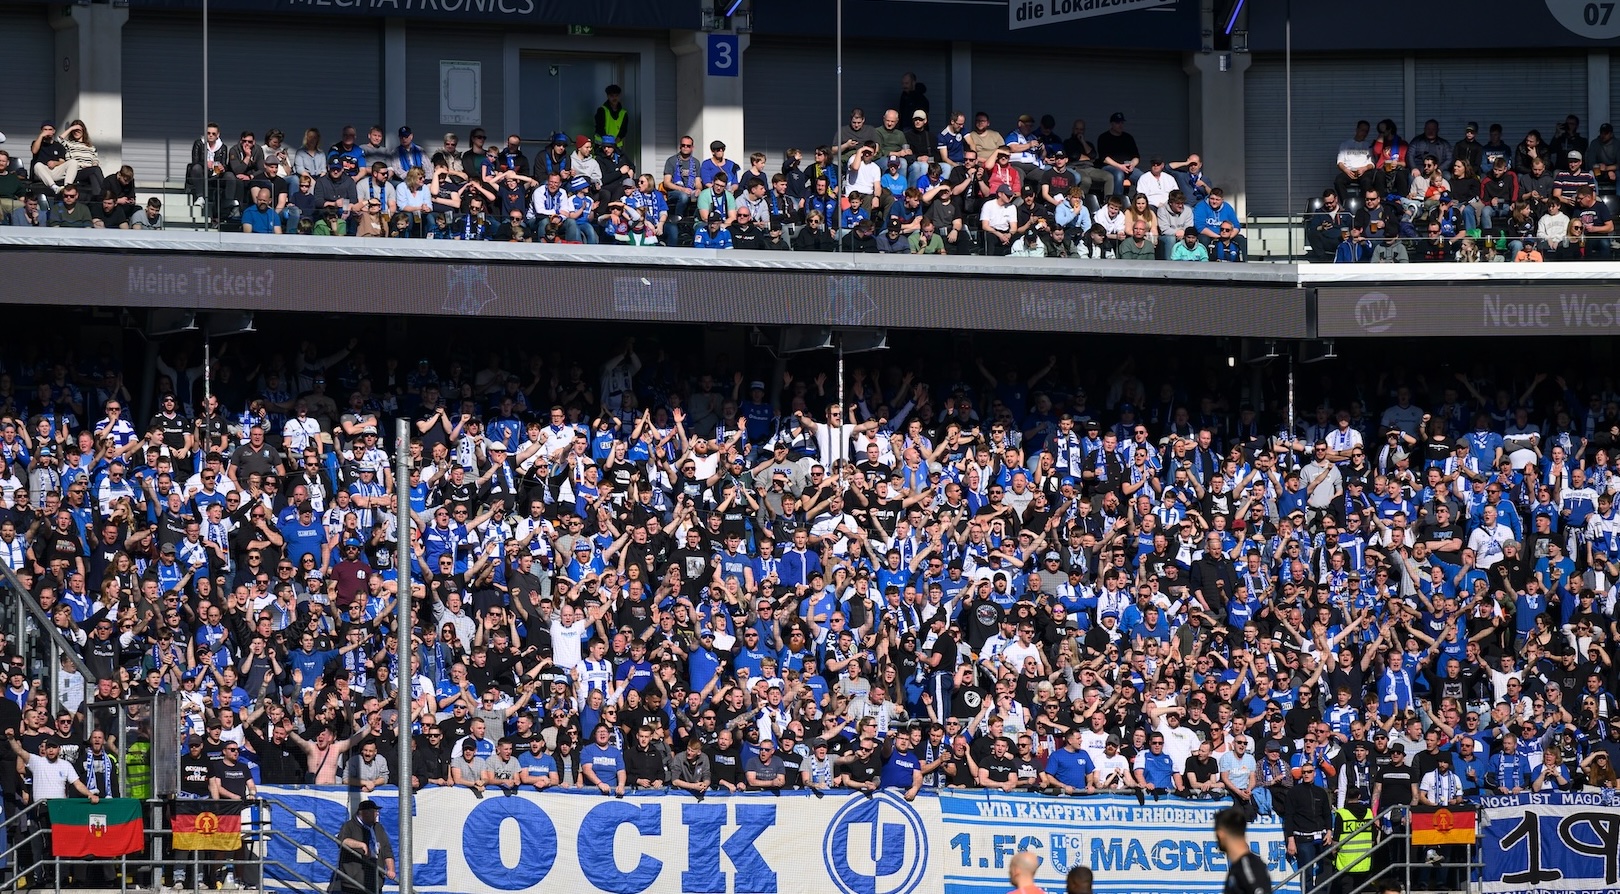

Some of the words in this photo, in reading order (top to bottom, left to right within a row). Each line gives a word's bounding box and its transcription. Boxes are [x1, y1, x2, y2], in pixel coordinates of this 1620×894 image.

[1016, 6, 1044, 22] die
[1584, 3, 1615, 26] 07
[714, 41, 732, 69] 3
[128, 265, 189, 294] Meine
[193, 267, 274, 297] Tickets?
[1021, 292, 1077, 319] Meine
[1081, 293, 1156, 322] Tickets?
[1360, 296, 1391, 317] NW
[1483, 293, 1551, 327] Neue
[976, 802, 1013, 818] WIR
[1015, 801, 1097, 822] KÄMPFEN
[1099, 805, 1133, 822] MIT
[1133, 807, 1219, 825] ERHOBENE
[1480, 795, 1520, 808] NOCH
[1528, 793, 1551, 805] IST
[1562, 793, 1620, 808] MAGDB
[258, 793, 778, 894] BLOCK
